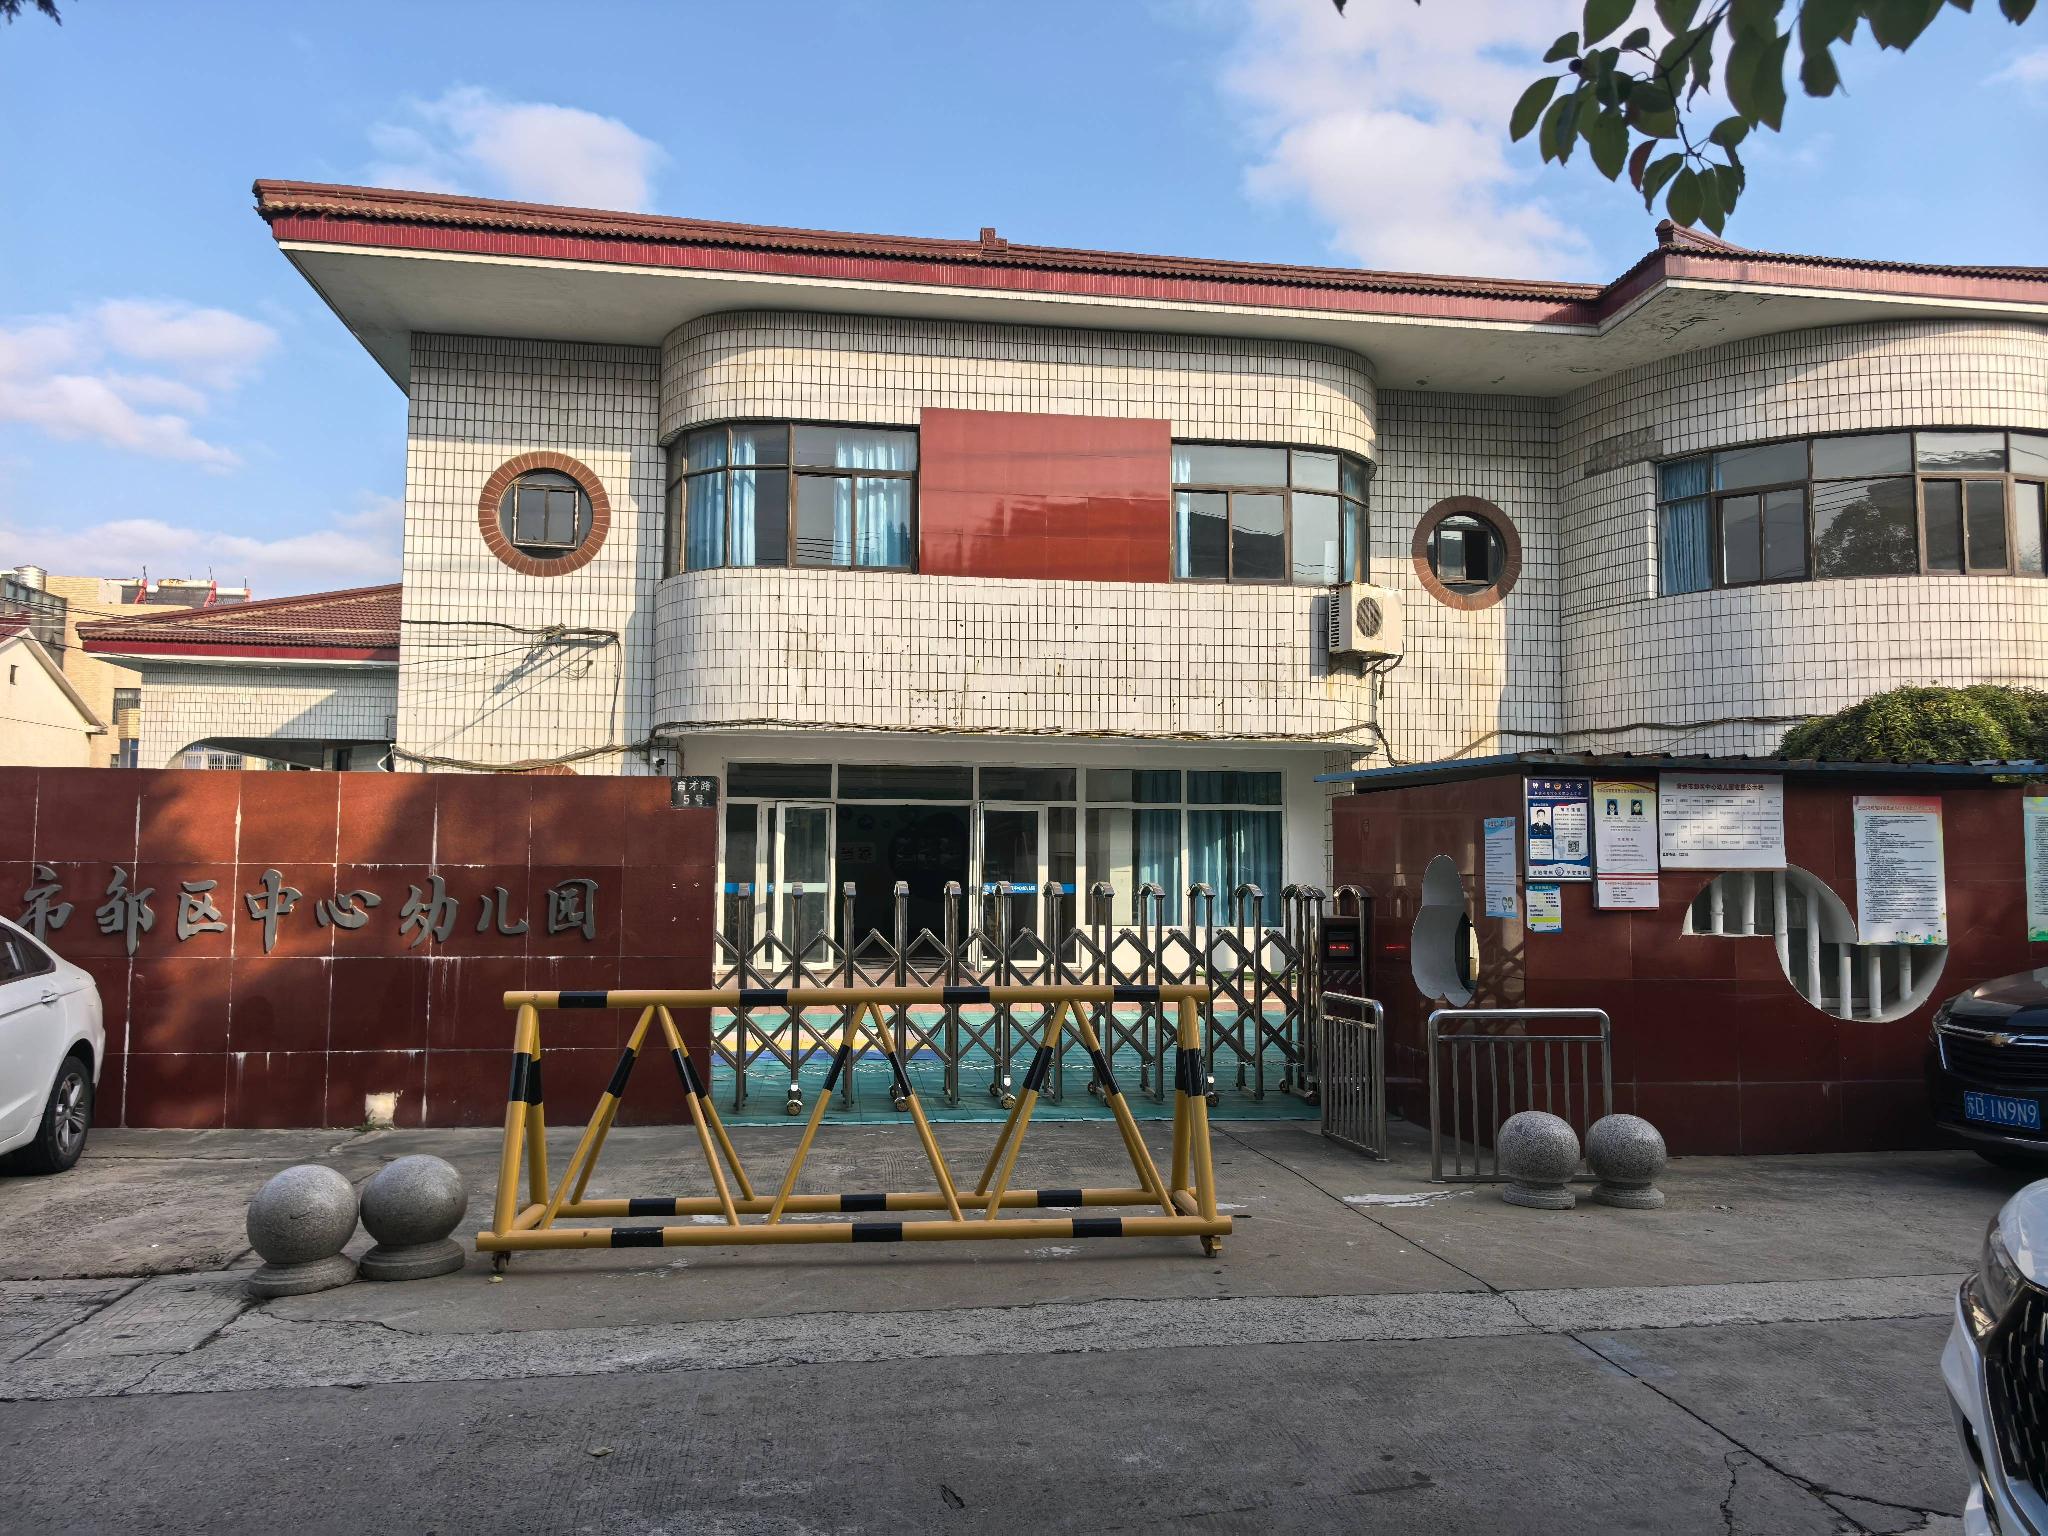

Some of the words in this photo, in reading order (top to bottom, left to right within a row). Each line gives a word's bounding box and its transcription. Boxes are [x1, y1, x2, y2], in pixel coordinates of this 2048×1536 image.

[676, 780, 711, 791] 育才路
[683, 794, 705, 805] 5号
[16, 864, 599, 956] 市邹区中心幼儿园
